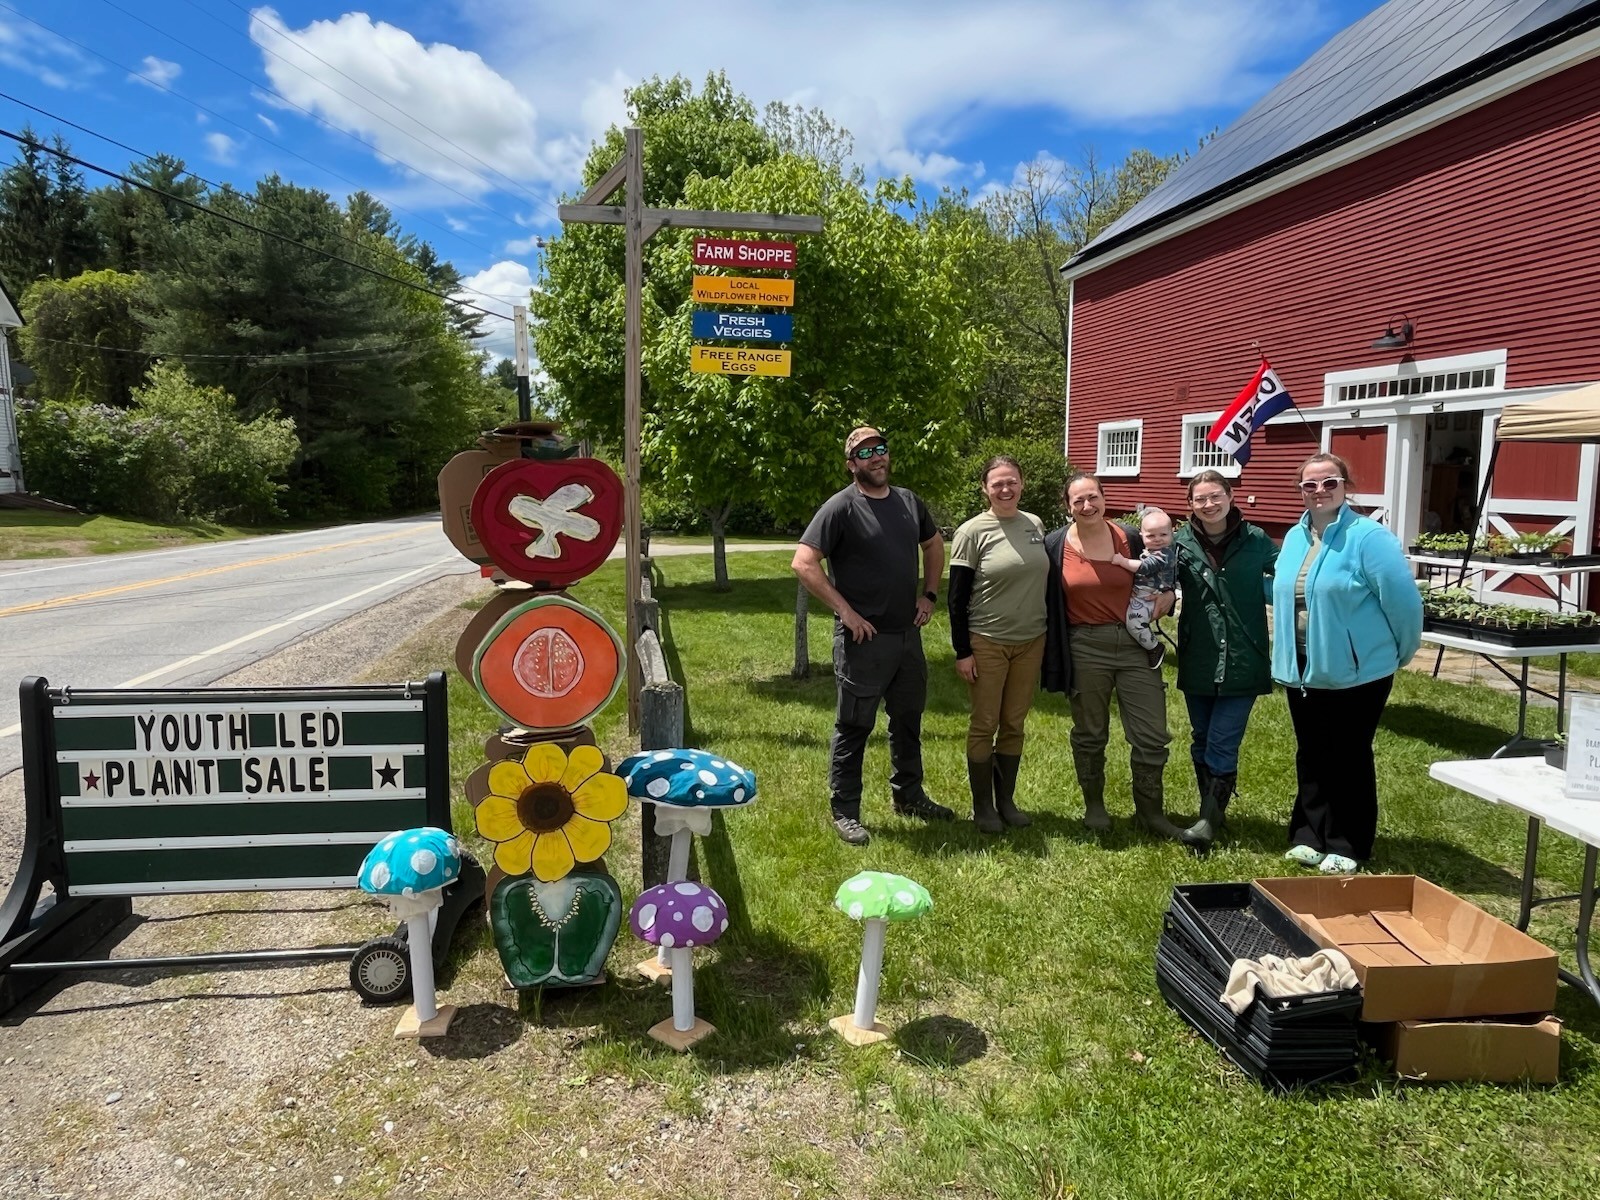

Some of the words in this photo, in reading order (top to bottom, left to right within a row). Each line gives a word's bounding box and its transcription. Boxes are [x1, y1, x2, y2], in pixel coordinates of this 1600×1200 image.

[697, 243, 733, 259] FARM
[739, 245, 792, 262] SHOPPE
[730, 280, 760, 290] LOCAL
[697, 290, 757, 301] WILDFLOWER
[759, 293, 789, 302] HONEY
[719, 314, 765, 327] FRESH
[713, 325, 772, 338] VEGGIES
[700, 349, 734, 360] FREE
[737, 351, 782, 362] RANGE
[721, 361, 757, 372] EGGS
[136, 713, 249, 752] YOUTH
[278, 712, 341, 748] LED
[105, 759, 216, 797] PLANT
[244, 757, 325, 793] SALE
